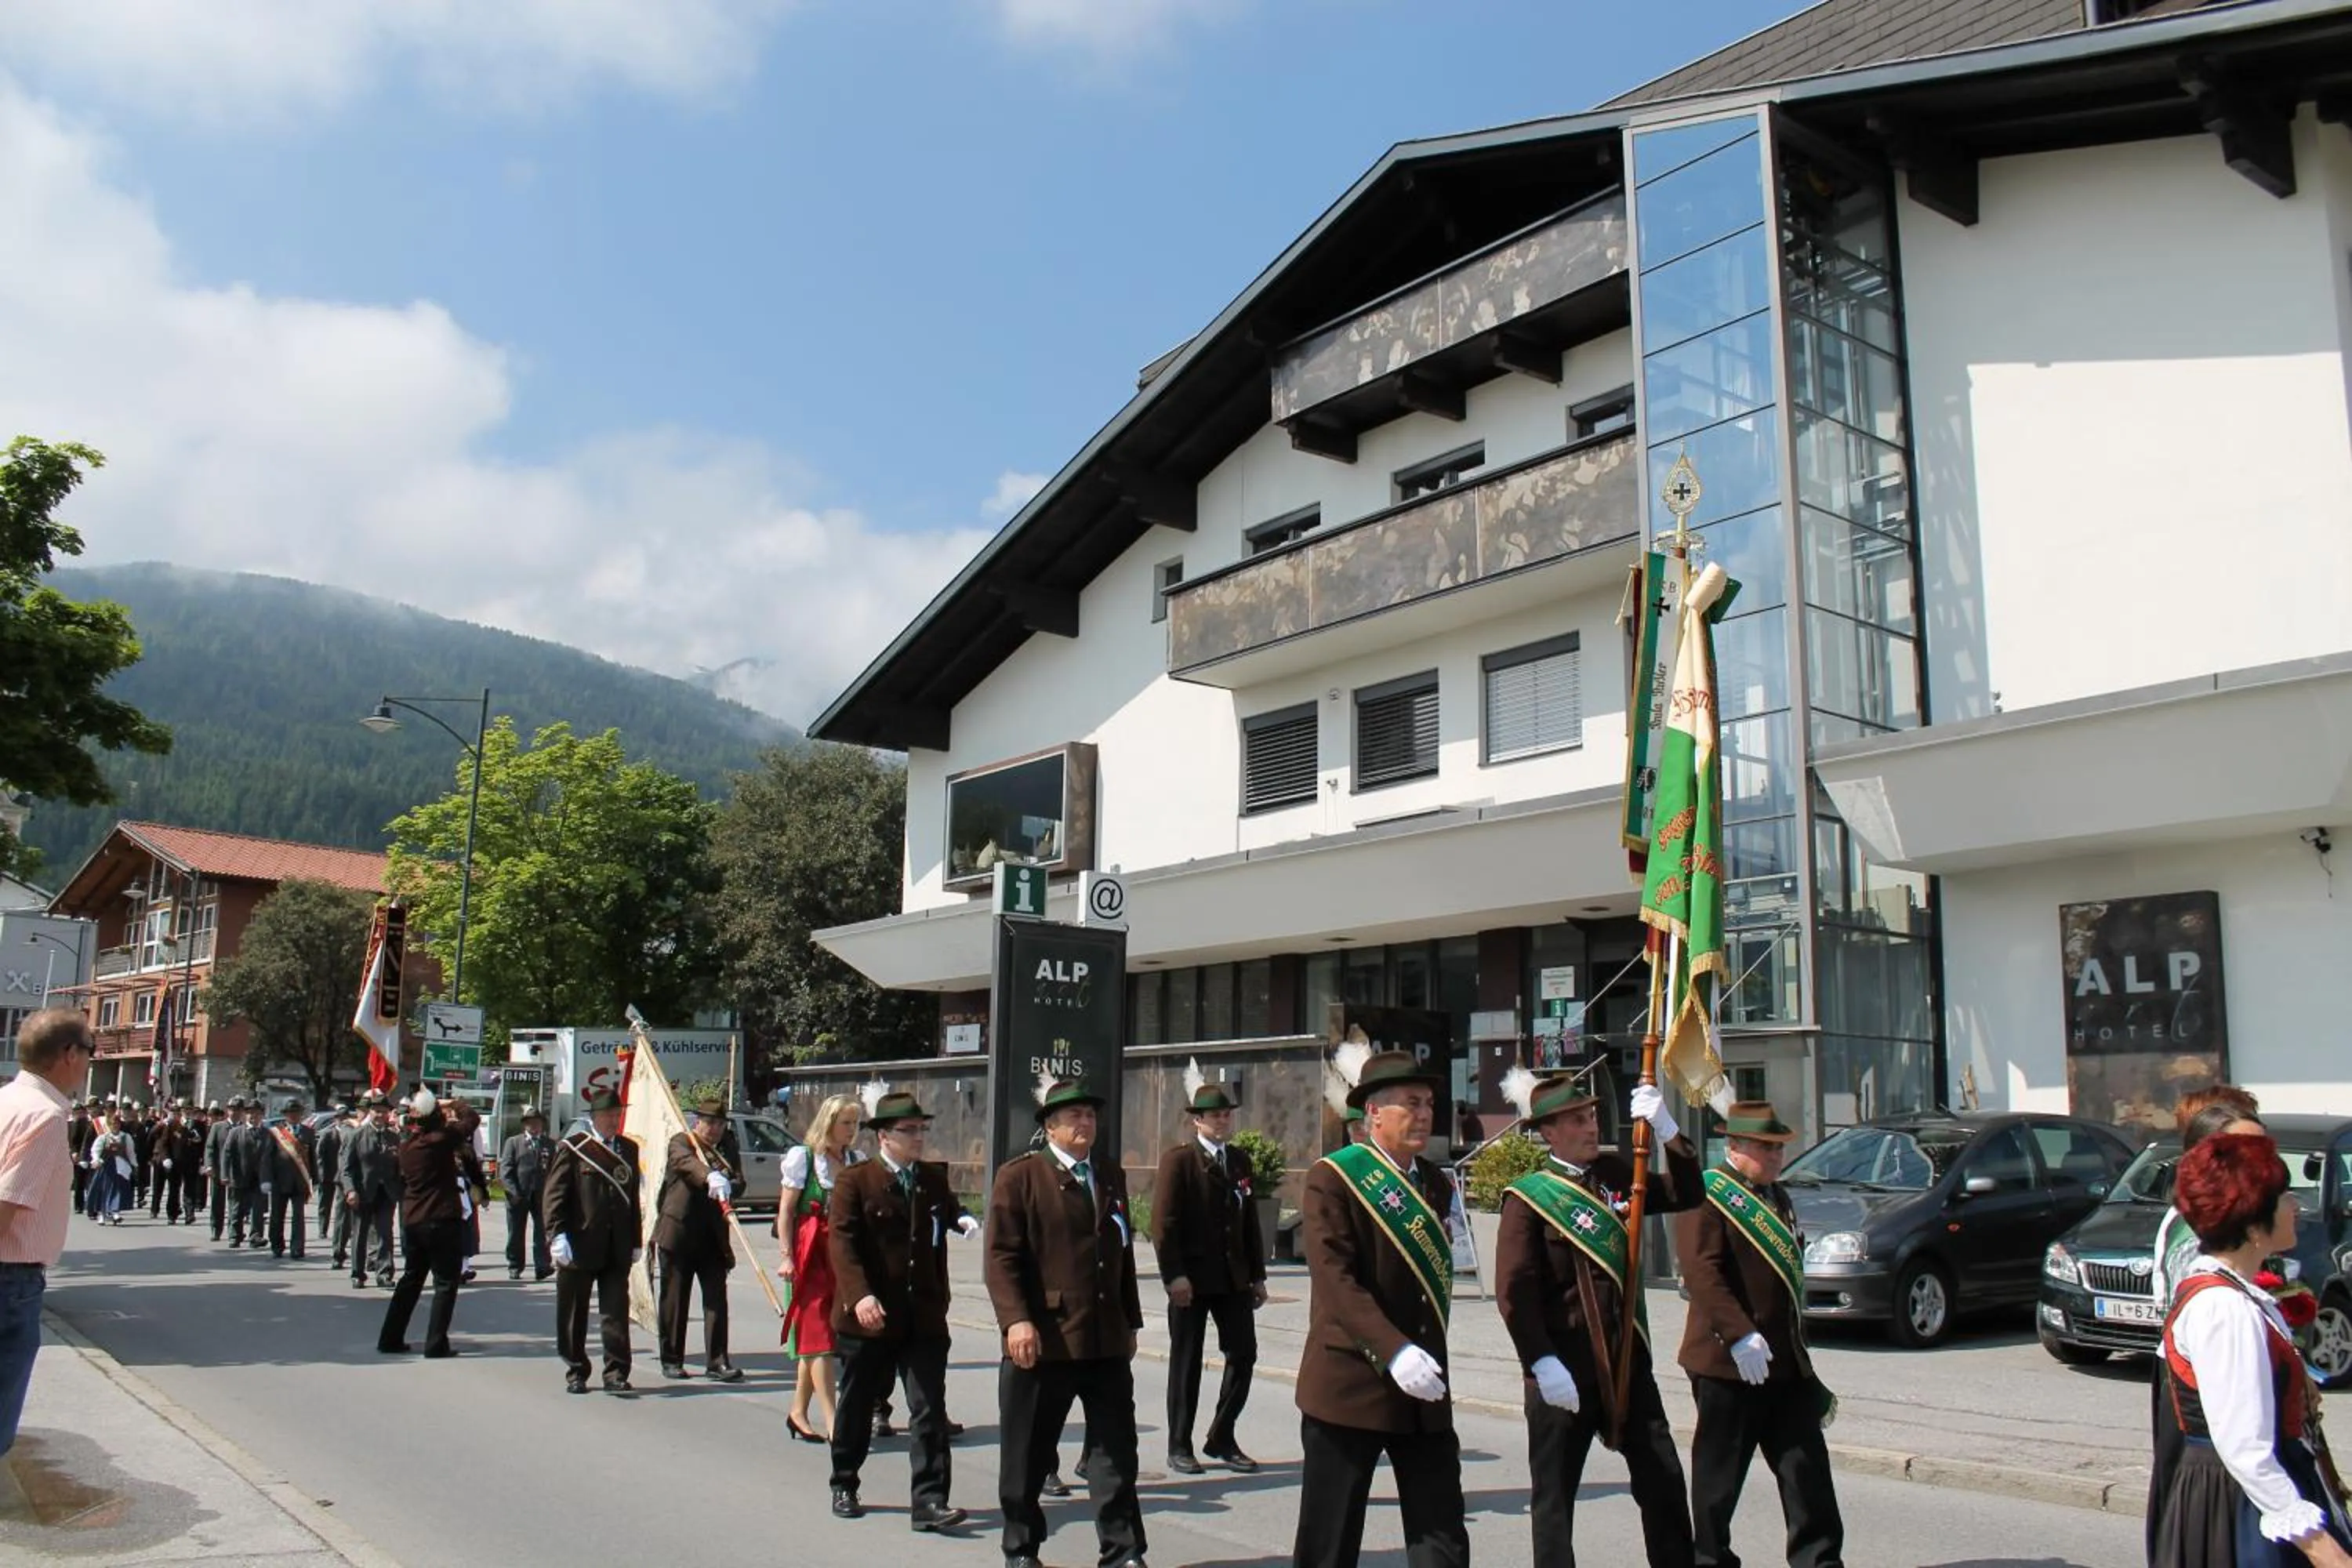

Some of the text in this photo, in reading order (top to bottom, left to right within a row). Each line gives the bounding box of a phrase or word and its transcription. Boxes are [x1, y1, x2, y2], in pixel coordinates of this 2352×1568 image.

[1035, 959, 1089, 982] ALP
[2074, 951, 2201, 996] ALP
[1034, 996, 1083, 1008] HOTEL
[2074, 1023, 2189, 1041] HOTEL
[1030, 1056, 1083, 1076] BINIS
[506, 1071, 540, 1082] BINIS
